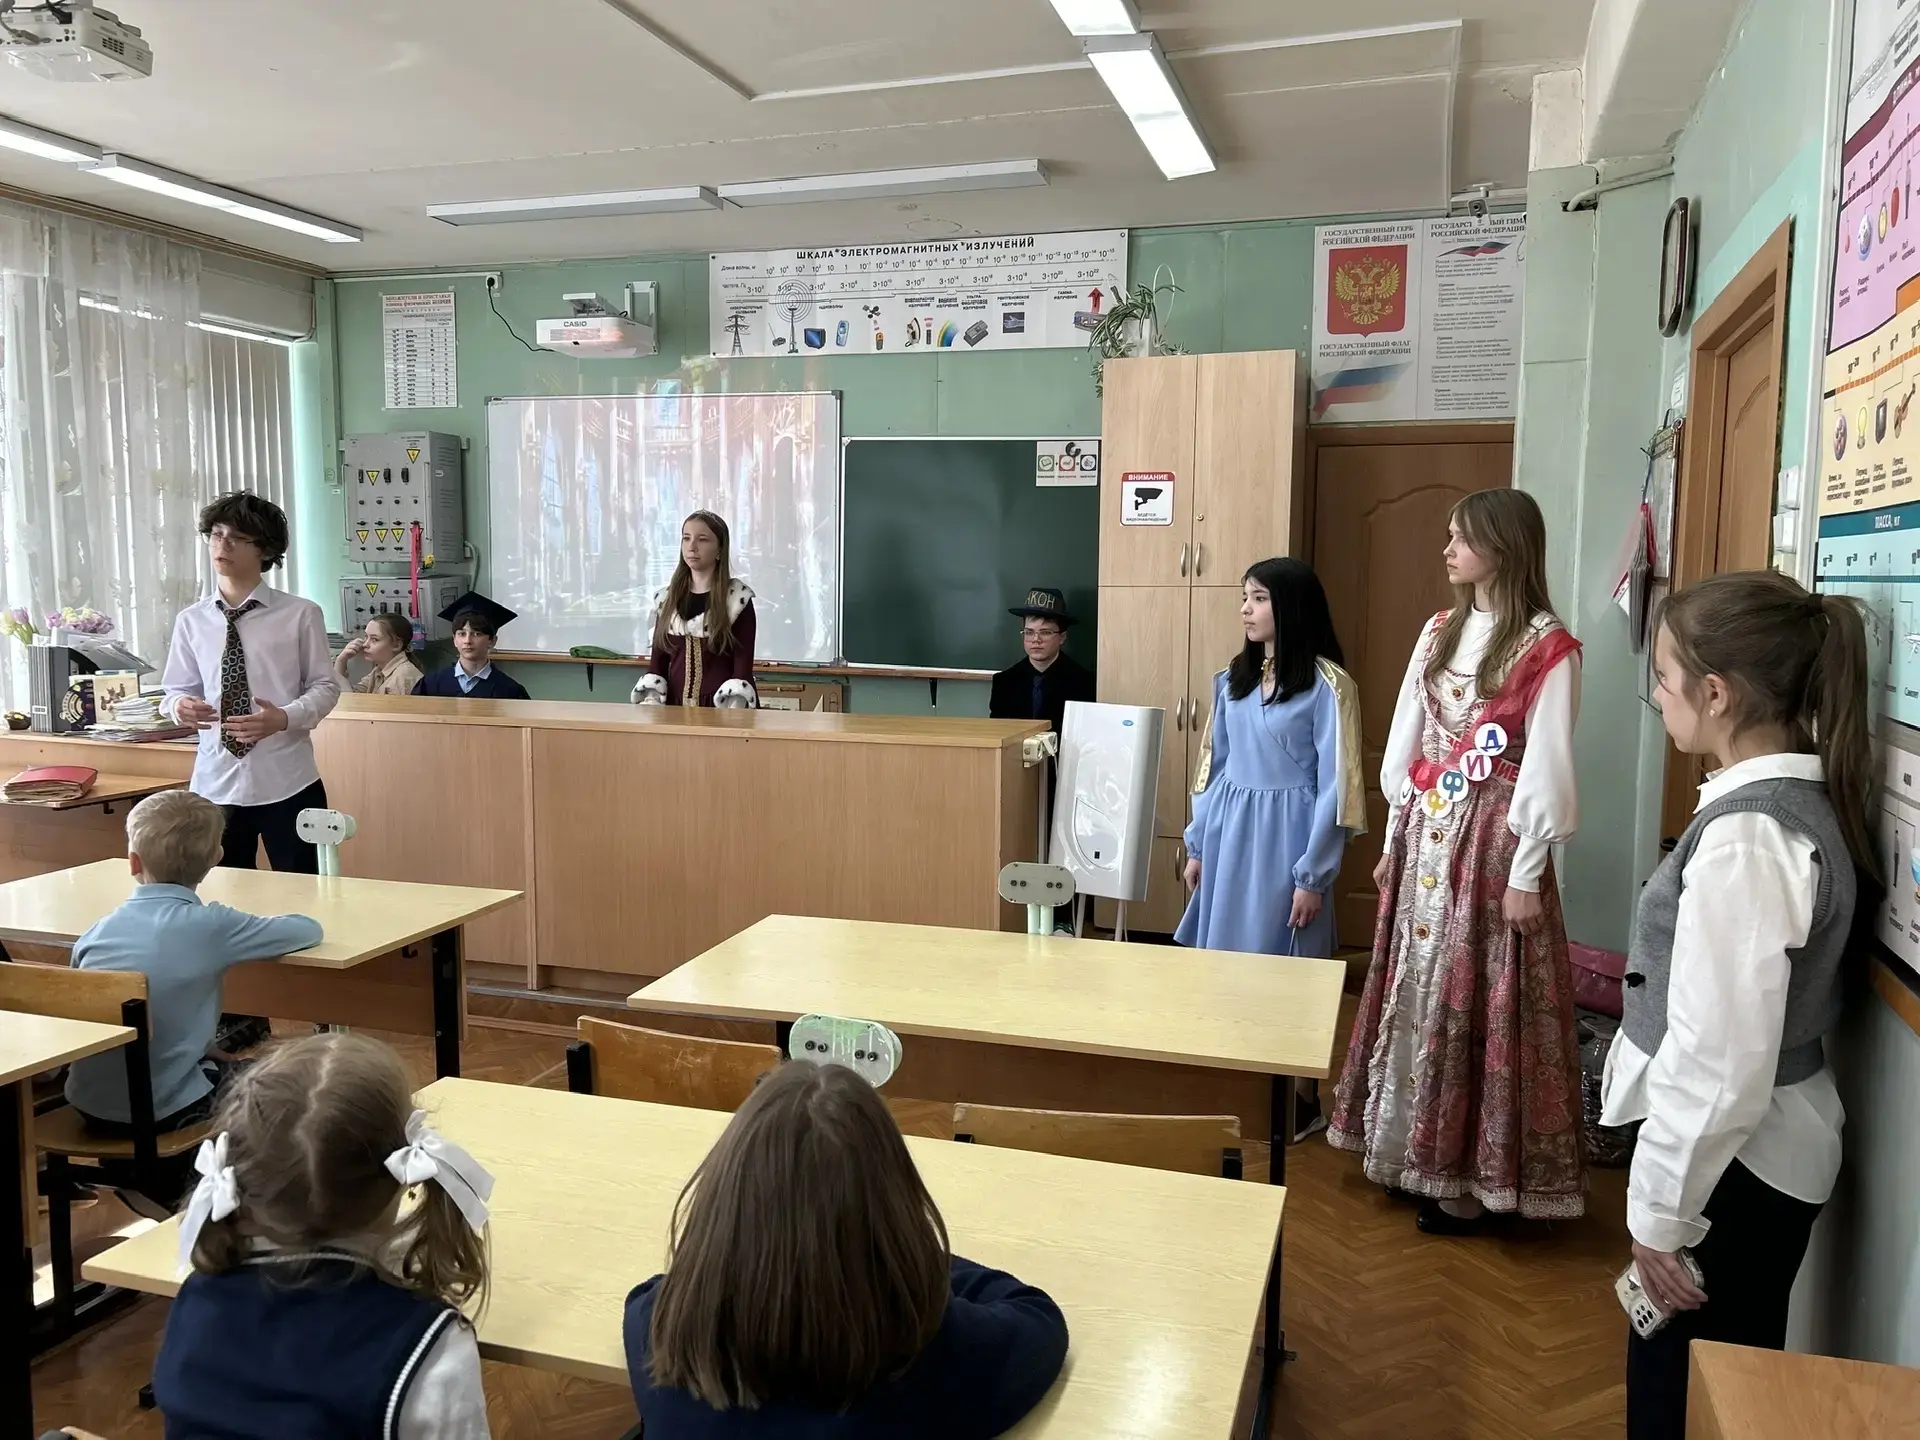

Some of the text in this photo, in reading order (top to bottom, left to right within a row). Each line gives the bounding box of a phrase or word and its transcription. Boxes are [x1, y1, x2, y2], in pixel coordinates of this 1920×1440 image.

[1325, 226, 1394, 236] ГОСУДАРСТВЕННЫЙ
[1431, 228, 1480, 238] РОССИЙСКОЙ
[1322, 233, 1415, 245] РОССИЙСКОЙ ФЕДЕРАЦИИ
[796, 237, 1034, 259] ШКАЛА ЭЛЕКТРОМАГНИТНЫХ ИЗЛУЧЕНИЙ
[1320, 340, 1389, 350] ГОСУДАРСТВЕННЫЙ
[1320, 348, 1411, 357] РОССИЙСКОЙ ФЕДЕРАЦИИ
